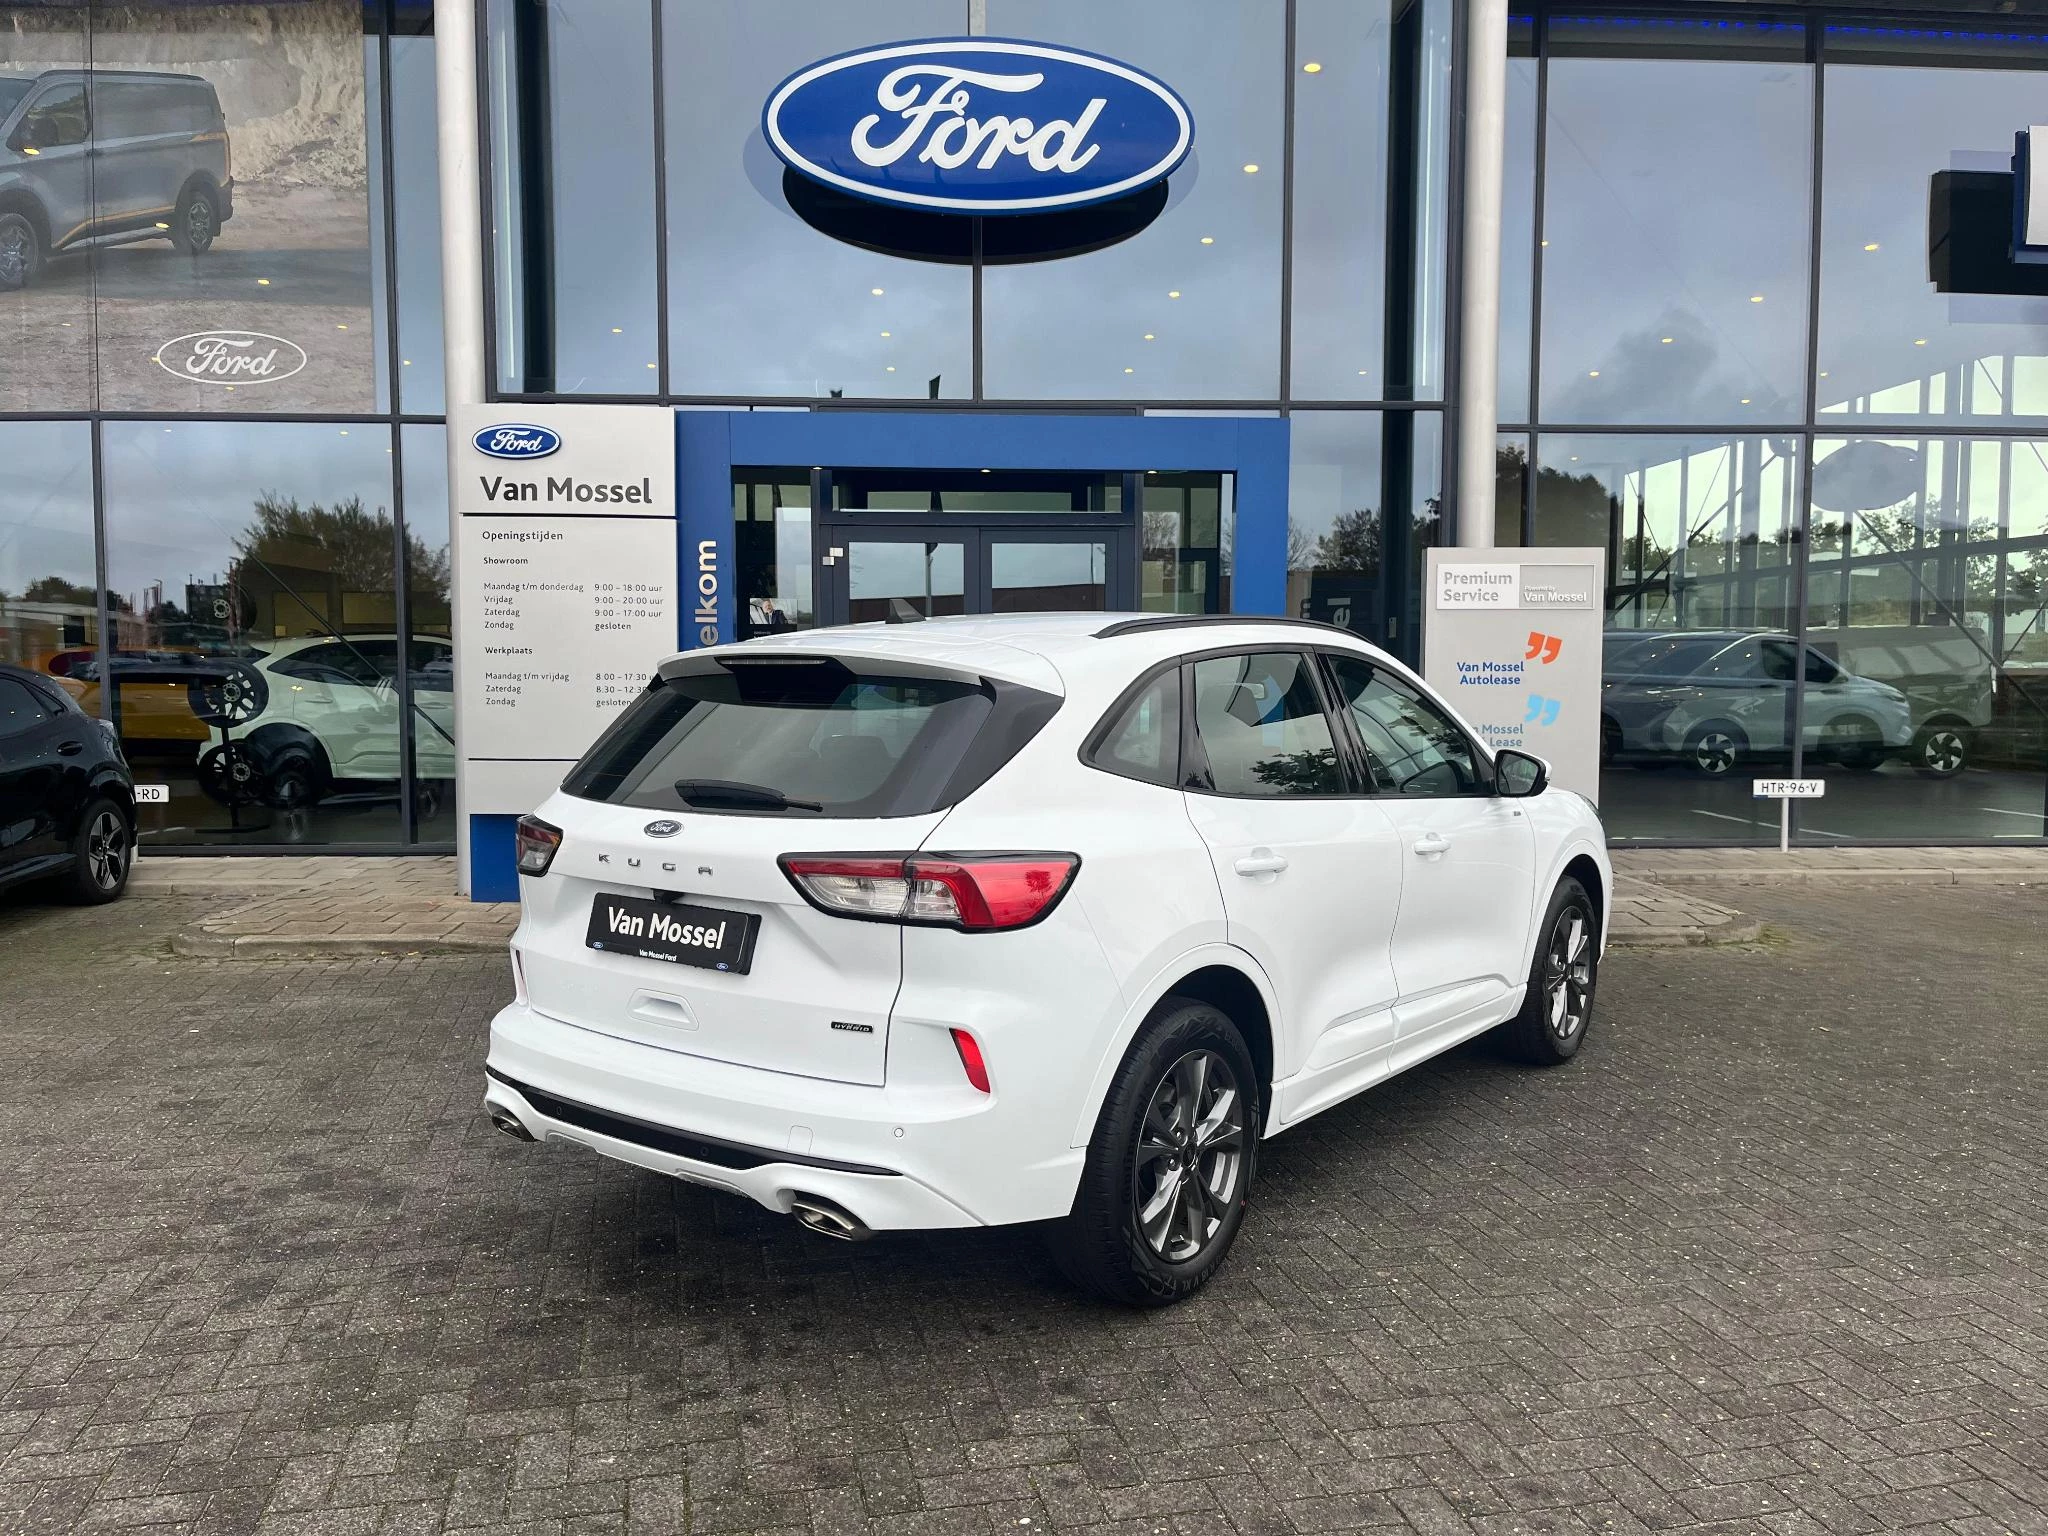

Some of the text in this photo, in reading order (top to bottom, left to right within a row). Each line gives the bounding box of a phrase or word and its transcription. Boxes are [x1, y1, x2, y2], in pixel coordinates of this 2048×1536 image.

[851, 64, 1108, 173] Ford
[186, 337, 278, 376] Ford
[490, 429, 543, 452] Ford
[480, 476, 653, 504] Van Mossel
[482, 531, 563, 542] Openingstijden
[483, 556, 529, 565] Showroom
[1444, 571, 1512, 585] Premium
[483, 582, 584, 592] Maandag t/m donderdag
[695, 540, 719, 648] elkom
[1443, 589, 1499, 602] Service
[1524, 592, 1587, 602] Van Mossel
[484, 595, 513, 605] Vrijdag
[484, 608, 520, 617] Zaterdag
[484, 621, 514, 630] Zondag
[594, 622, 632, 631] gesloten
[484, 646, 533, 656] Werkplaats
[1456, 661, 1525, 673] Van Mossel
[485, 672, 522, 682] Maandag
[541, 672, 570, 682] vrijdag
[1460, 674, 1521, 686] Autolease
[485, 685, 522, 694] Zaterdag
[486, 698, 516, 708] Zondag
[595, 699, 632, 708] gesloten
[1482, 723, 1524, 735] Mossel
[1489, 737, 1523, 747] Lease
[1761, 782, 1818, 793] HTR-96-V
[598, 853, 714, 876] KUGA
[608, 906, 727, 950] Van Mossel
[639, 949, 677, 962] Van Mossel Ford
